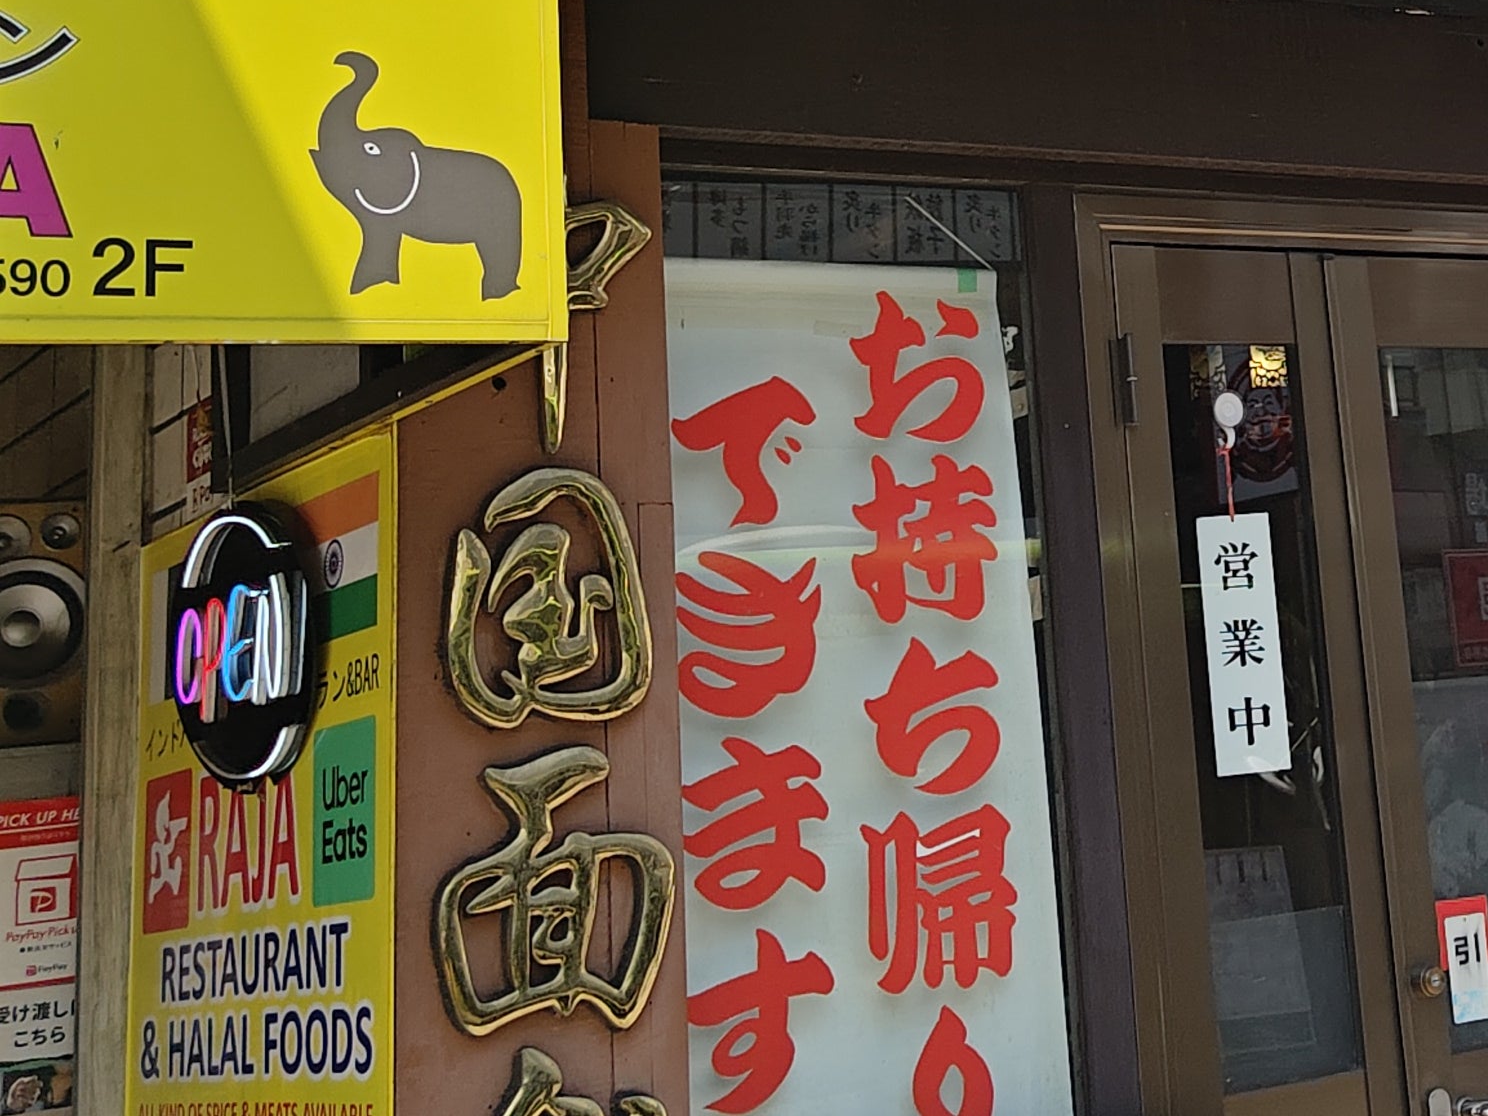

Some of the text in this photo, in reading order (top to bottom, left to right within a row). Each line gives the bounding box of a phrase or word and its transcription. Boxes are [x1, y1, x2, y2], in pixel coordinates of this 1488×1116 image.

[93, 239, 194, 297] 2F
[176, 572, 307, 722] OPEN
[1215, 541, 1272, 747] 営業中
[850, 290, 1018, 1116] お持ち帰り
[672, 375, 836, 1115] できます
[36, 810, 57, 824] UP
[322, 765, 369, 811] Uber
[199, 772, 300, 912] RAJA
[321, 818, 368, 864] Eats
[161, 922, 349, 1003] RESTAURANT
[1454, 931, 1481, 966] 引
[0, 999, 76, 1024] 受け渡し
[14, 1026, 66, 1048] こちら
[140, 1006, 373, 1080] & HALAL FOODS
